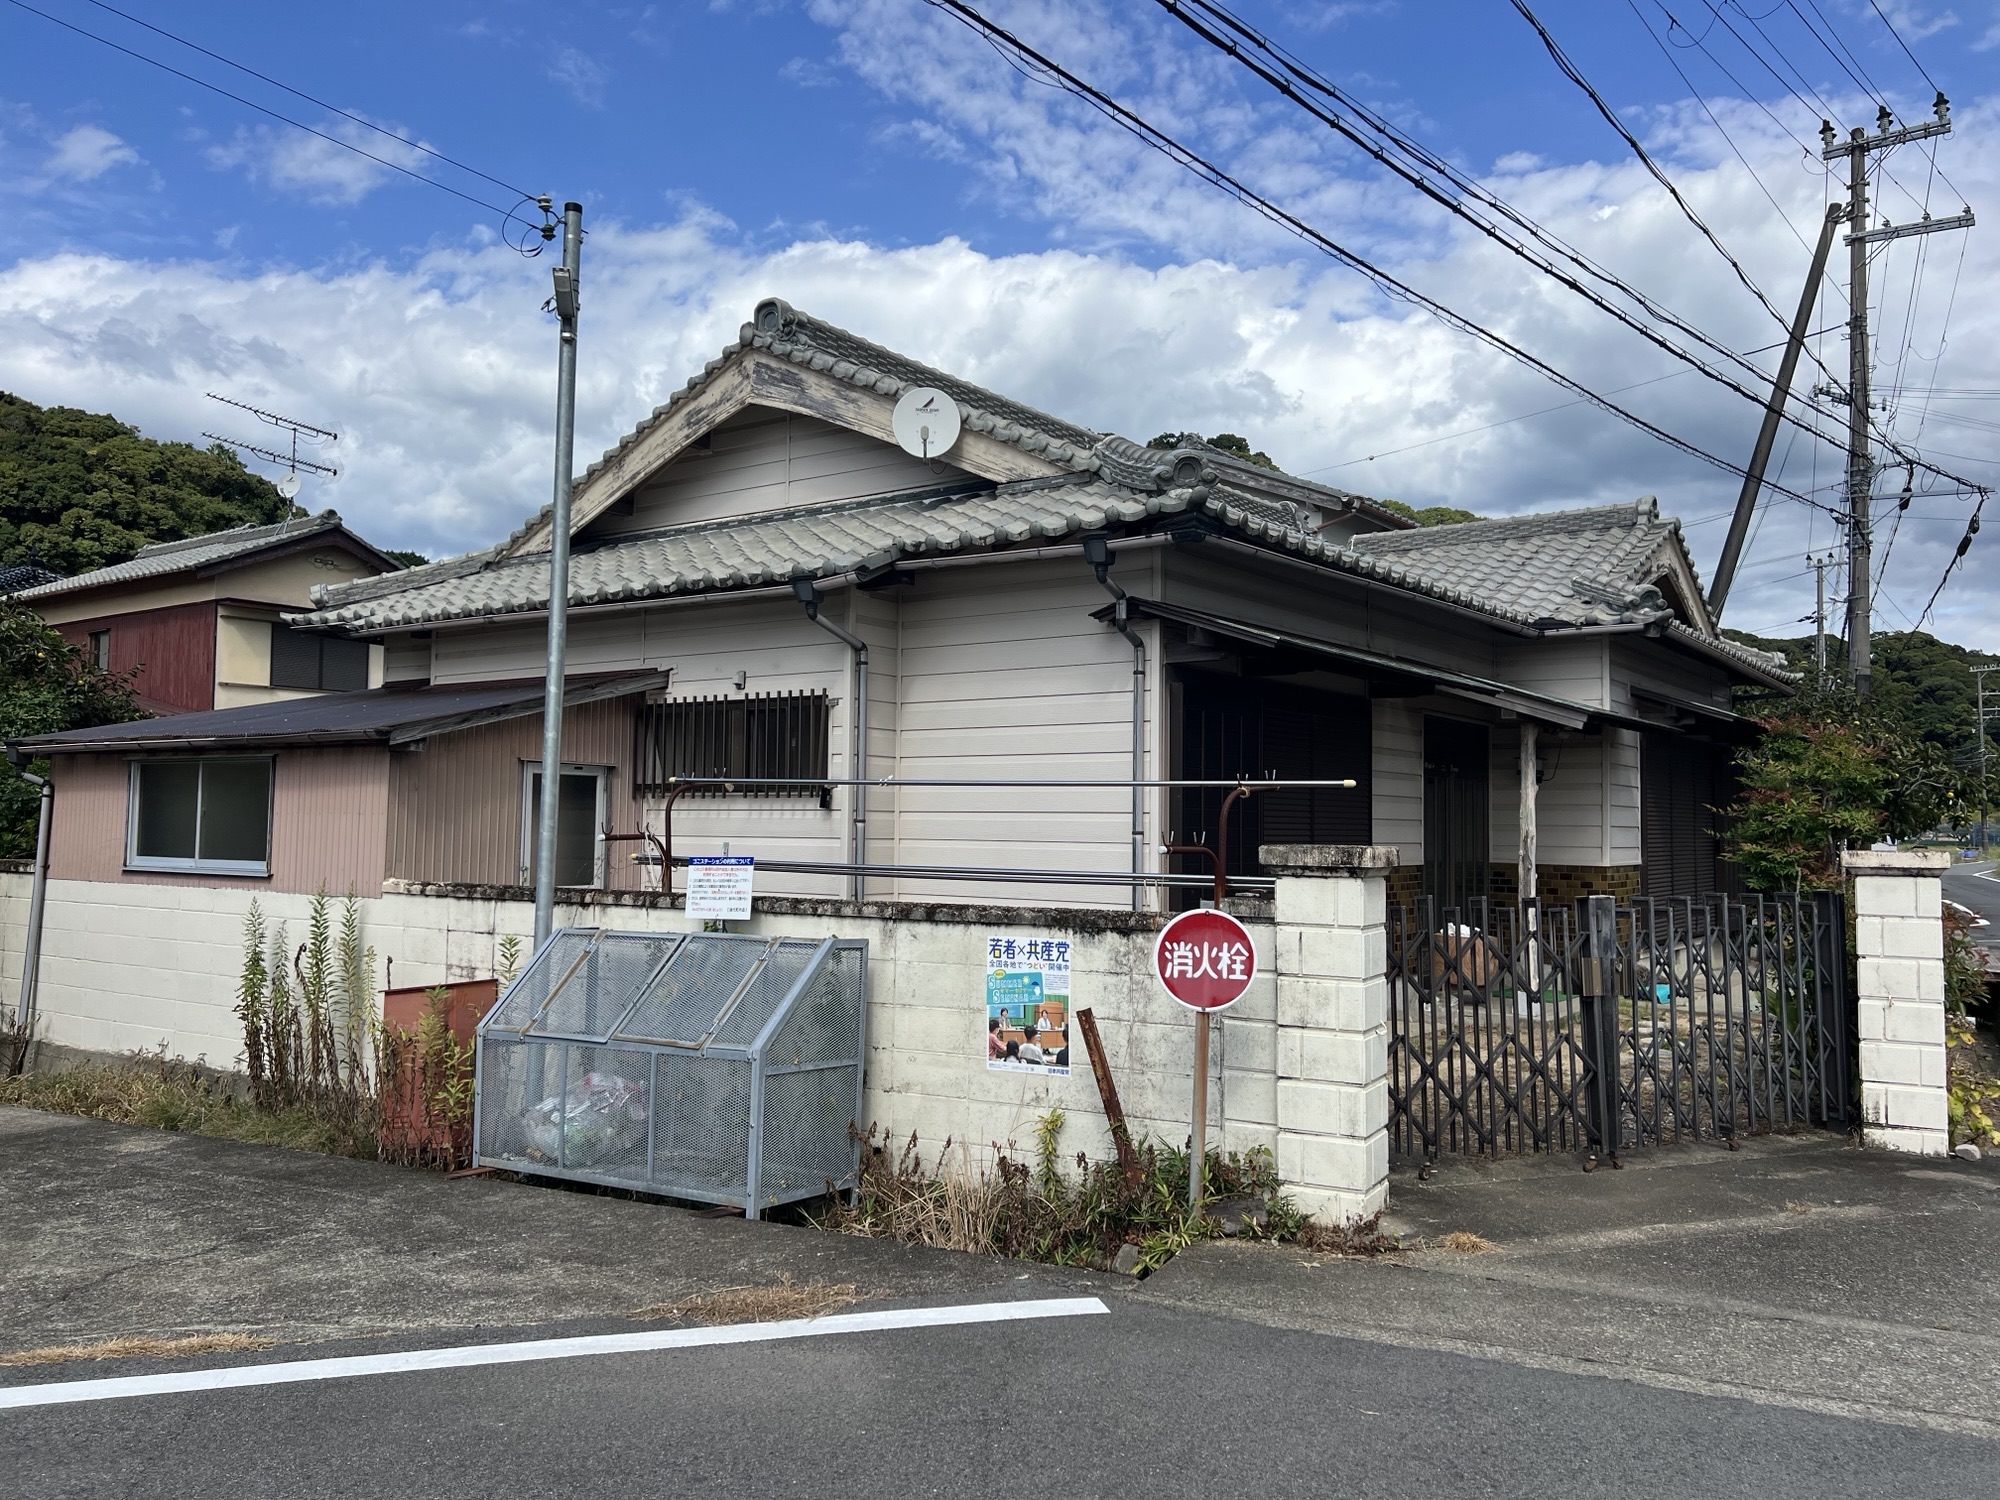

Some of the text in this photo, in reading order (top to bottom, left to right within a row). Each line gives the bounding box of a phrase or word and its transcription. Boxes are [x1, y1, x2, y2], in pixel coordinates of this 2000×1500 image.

[989, 938, 1069, 962] 若者×共産党
[1164, 941, 1249, 980] 消火栓
